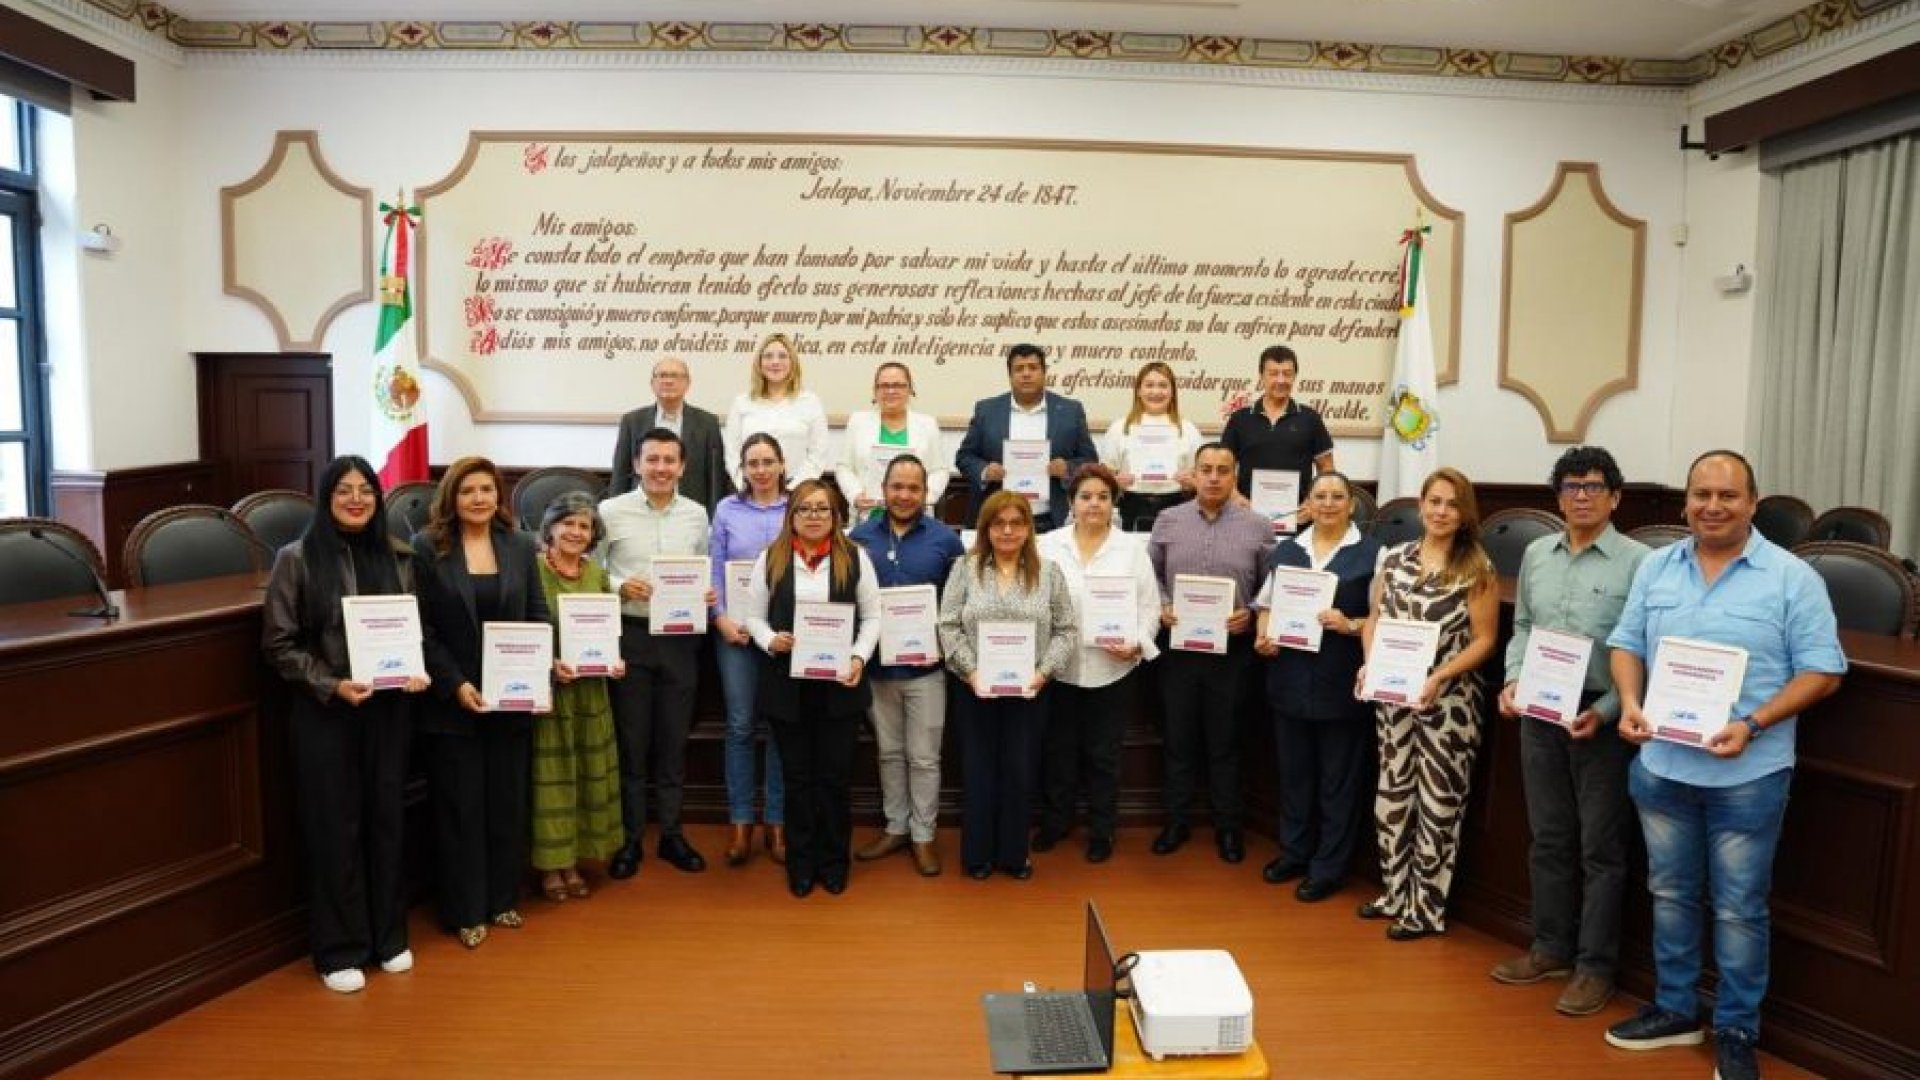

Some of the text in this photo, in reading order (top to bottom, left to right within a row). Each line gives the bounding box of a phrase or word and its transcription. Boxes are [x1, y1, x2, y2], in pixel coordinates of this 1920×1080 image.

[554, 146, 577, 168] los
[578, 145, 666, 173] jalapeños
[666, 156, 679, 173] y
[683, 155, 696, 168] a
[701, 147, 745, 169] todos
[747, 151, 777, 170] mis
[876, 177, 976, 202] Noviembre
[977, 183, 1003, 203] 24
[1004, 181, 1029, 203] de
[1033, 184, 1078, 206] 1847.
[532, 211, 566, 236] Mis
[524, 241, 581, 264] consta
[584, 242, 622, 264] todo
[627, 242, 647, 265] el
[648, 248, 716, 272] empeño
[720, 252, 749, 272] que
[753, 243, 788, 267] han
[795, 244, 859, 267] tomado
[860, 252, 894, 272] por
[901, 247, 960, 269] salvar
[964, 251, 990, 270] mi
[992, 248, 1033, 272] vida
[1034, 257, 1050, 278] y
[1056, 250, 1107, 273] hasta
[1111, 253, 1132, 274] el
[1132, 254, 1188, 276] último
[1194, 256, 1270, 278] momento
[1274, 257, 1289, 278] lo
[475, 271, 491, 292] lo
[494, 273, 549, 293] mismo
[554, 278, 587, 299] que
[612, 270, 692, 294] hubieran
[697, 273, 751, 295] tenido
[757, 274, 807, 301] efecto
[813, 283, 842, 296] sus
[842, 282, 939, 304] generosas
[944, 278, 1042, 306] reflexiones
[1042, 280, 1105, 301] hechas
[1107, 281, 1130, 302] al
[1124, 283, 1162, 308] jefe
[1164, 284, 1184, 304] de
[1186, 284, 1202, 304] la
[1197, 284, 1253, 310] fuerza
[1316, 296, 1332, 309] en
[504, 308, 522, 321] se
[525, 303, 594, 329] consiguió
[592, 309, 604, 327] y
[605, 308, 651, 322] muero
[716, 307, 770, 330] porque
[772, 310, 817, 324] muero
[817, 308, 845, 330] por
[846, 307, 867, 325] mi
[957, 307, 978, 327] les
[980, 307, 1032, 333] suplico
[1035, 315, 1060, 335] que
[1062, 310, 1100, 329] estos
[1103, 311, 1182, 332] asesinatos
[1185, 319, 1204, 332] no
[1287, 320, 1325, 341] para
[543, 331, 571, 350] mis
[639, 337, 658, 352] no
[734, 334, 758, 352] mi
[827, 341, 846, 355] en
[850, 334, 888, 355] esta
[892, 334, 995, 365] inteligencia
[1071, 345, 1122, 360] muero
[1130, 340, 1197, 361] contento.
[1062, 369, 1137, 394] afectísim
[1299, 379, 1325, 393] sus
[1329, 381, 1386, 396] manos
